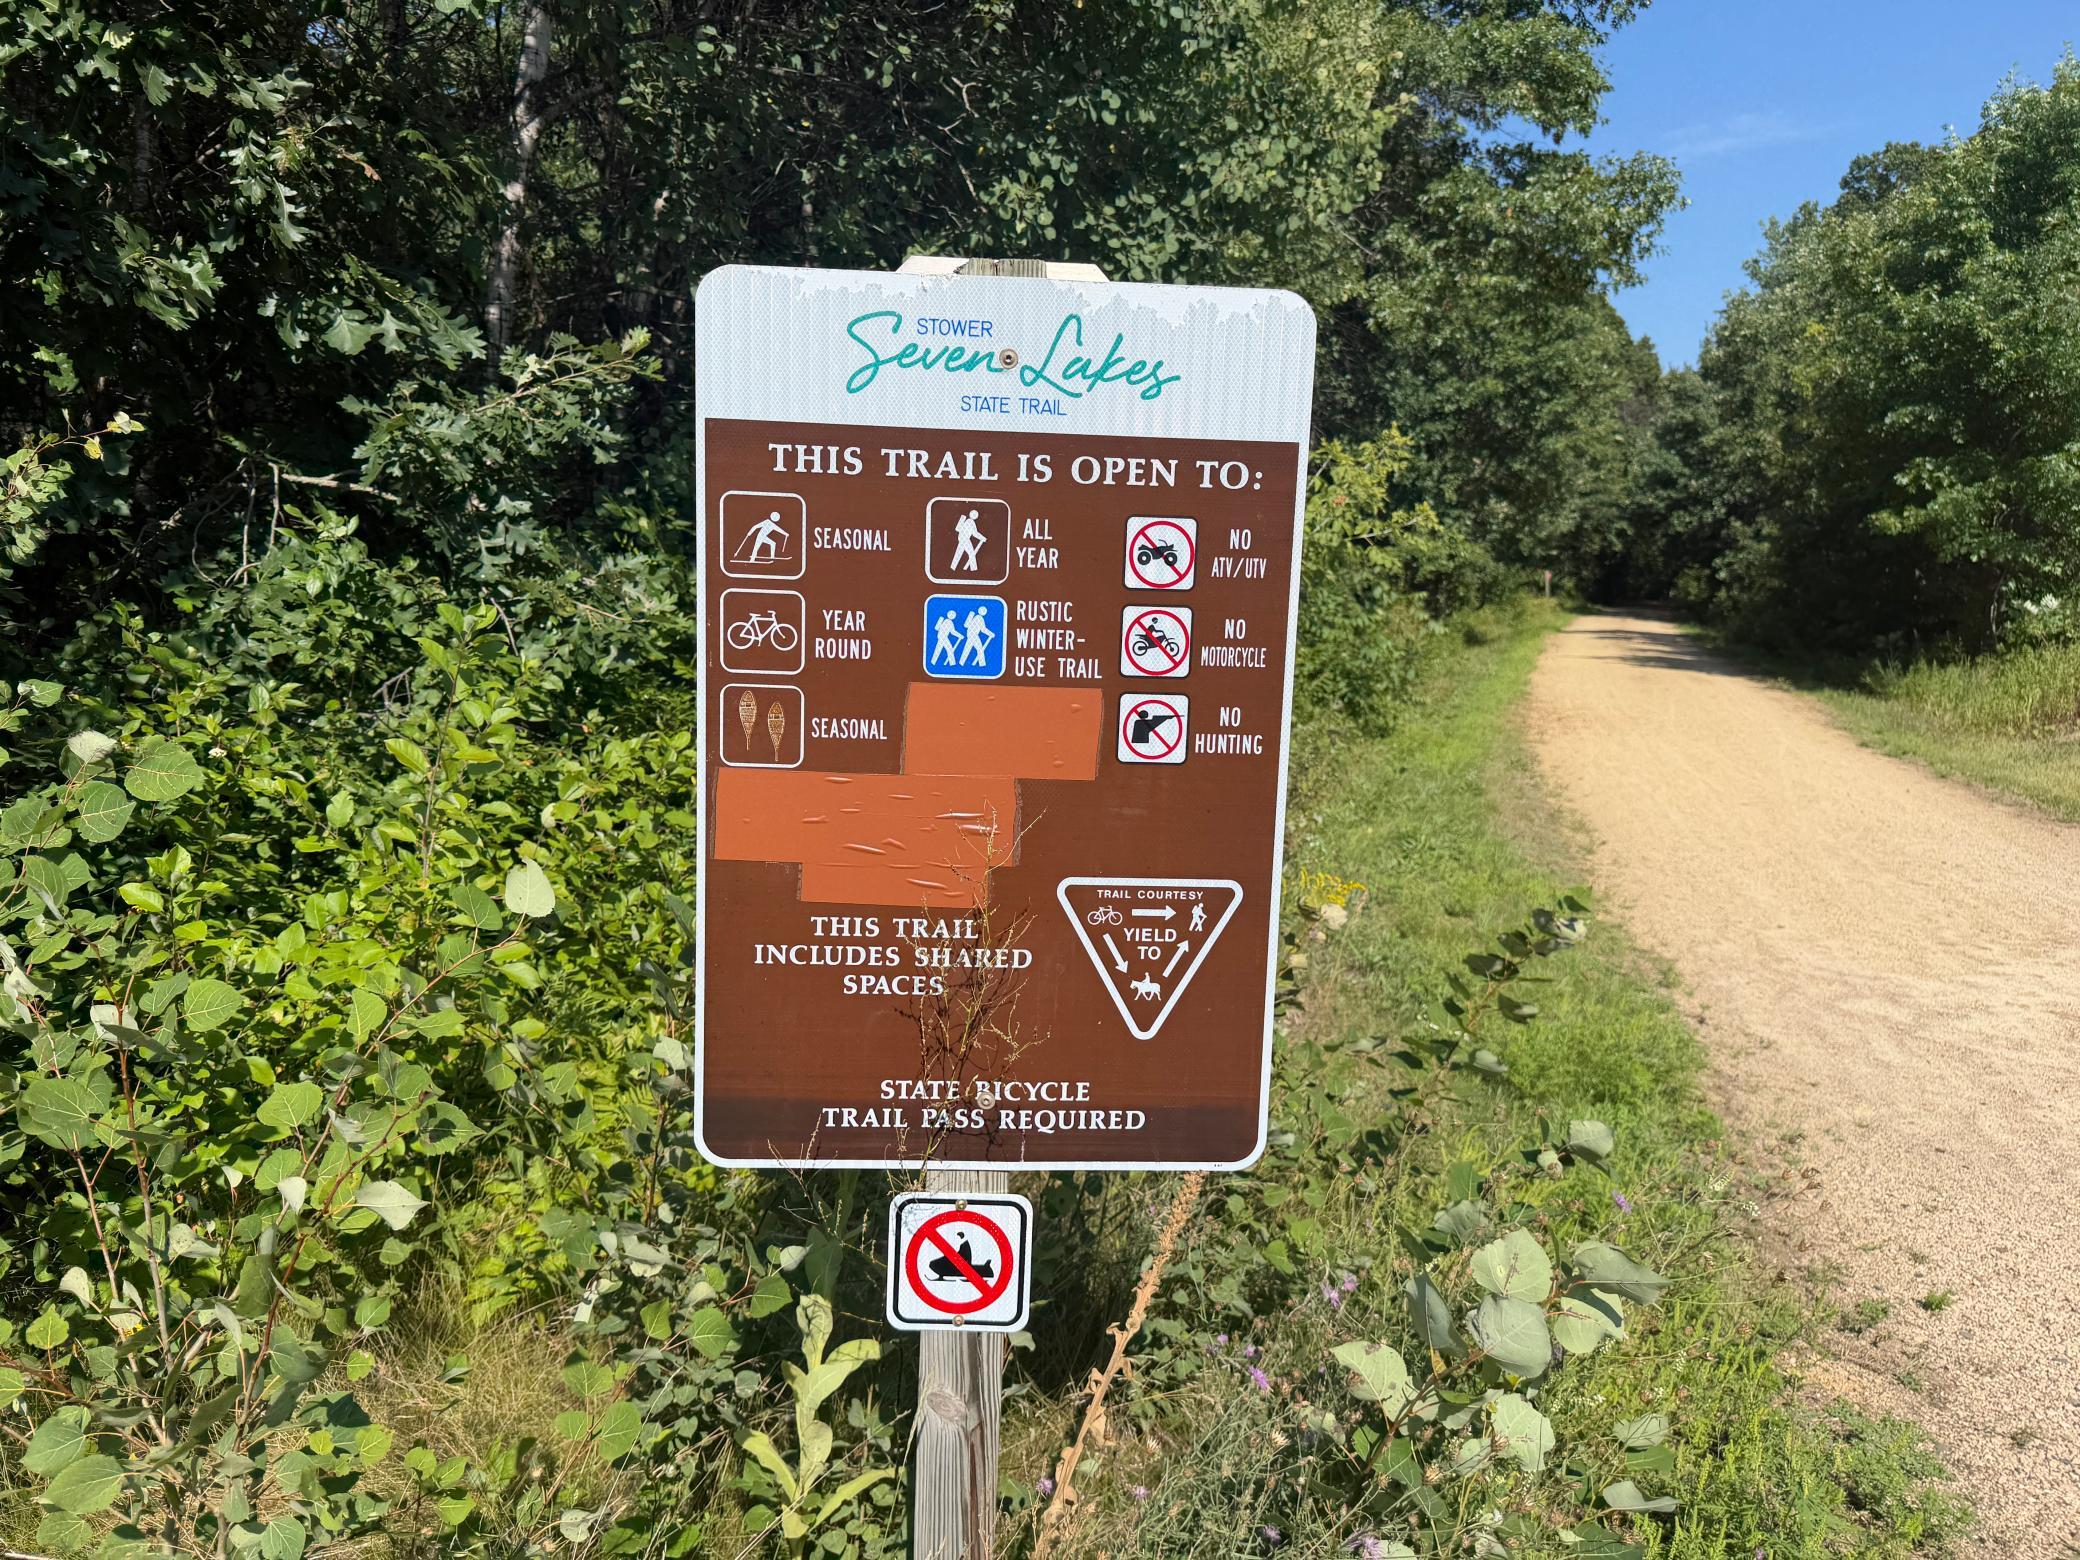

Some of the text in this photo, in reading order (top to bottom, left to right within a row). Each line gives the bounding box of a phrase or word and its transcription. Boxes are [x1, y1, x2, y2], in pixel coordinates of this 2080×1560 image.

[918, 319, 993, 338] STOWER
[847, 312, 1180, 400] Seven Lakes
[961, 396, 1067, 416] STATE TRAIL
[769, 443, 1262, 490] THIS TRAIL IS OPEN TO:
[814, 527, 891, 551] SEASONAL
[1023, 519, 1052, 540] ALL
[1230, 529, 1251, 550] NO
[1016, 547, 1058, 568] YEAR
[1212, 557, 1266, 578] ATV/UTV
[823, 610, 865, 631] YEAR
[1017, 601, 1072, 622] RUSTIC
[1017, 629, 1085, 650] WINTER-
[1225, 619, 1245, 639] NO
[816, 638, 871, 659] ROUND
[1201, 646, 1266, 667] MOTORCYCLE
[1015, 657, 1102, 678] USE TRAIL
[1220, 707, 1240, 727] NO
[812, 718, 887, 739] SEASONAL
[1195, 734, 1262, 754] HUNTING
[1097, 890, 1204, 900] TRAIL COURTESY
[811, 917, 978, 939] THIS TRAIL
[1124, 928, 1176, 942] YIELD
[755, 945, 1032, 969] INCLUDES SHARED
[1138, 946, 1161, 960] TO
[844, 975, 943, 995] SPACES
[881, 1080, 960, 1099] STATE
[822, 1108, 1145, 1134] TRAIL PASS REQUIRED
